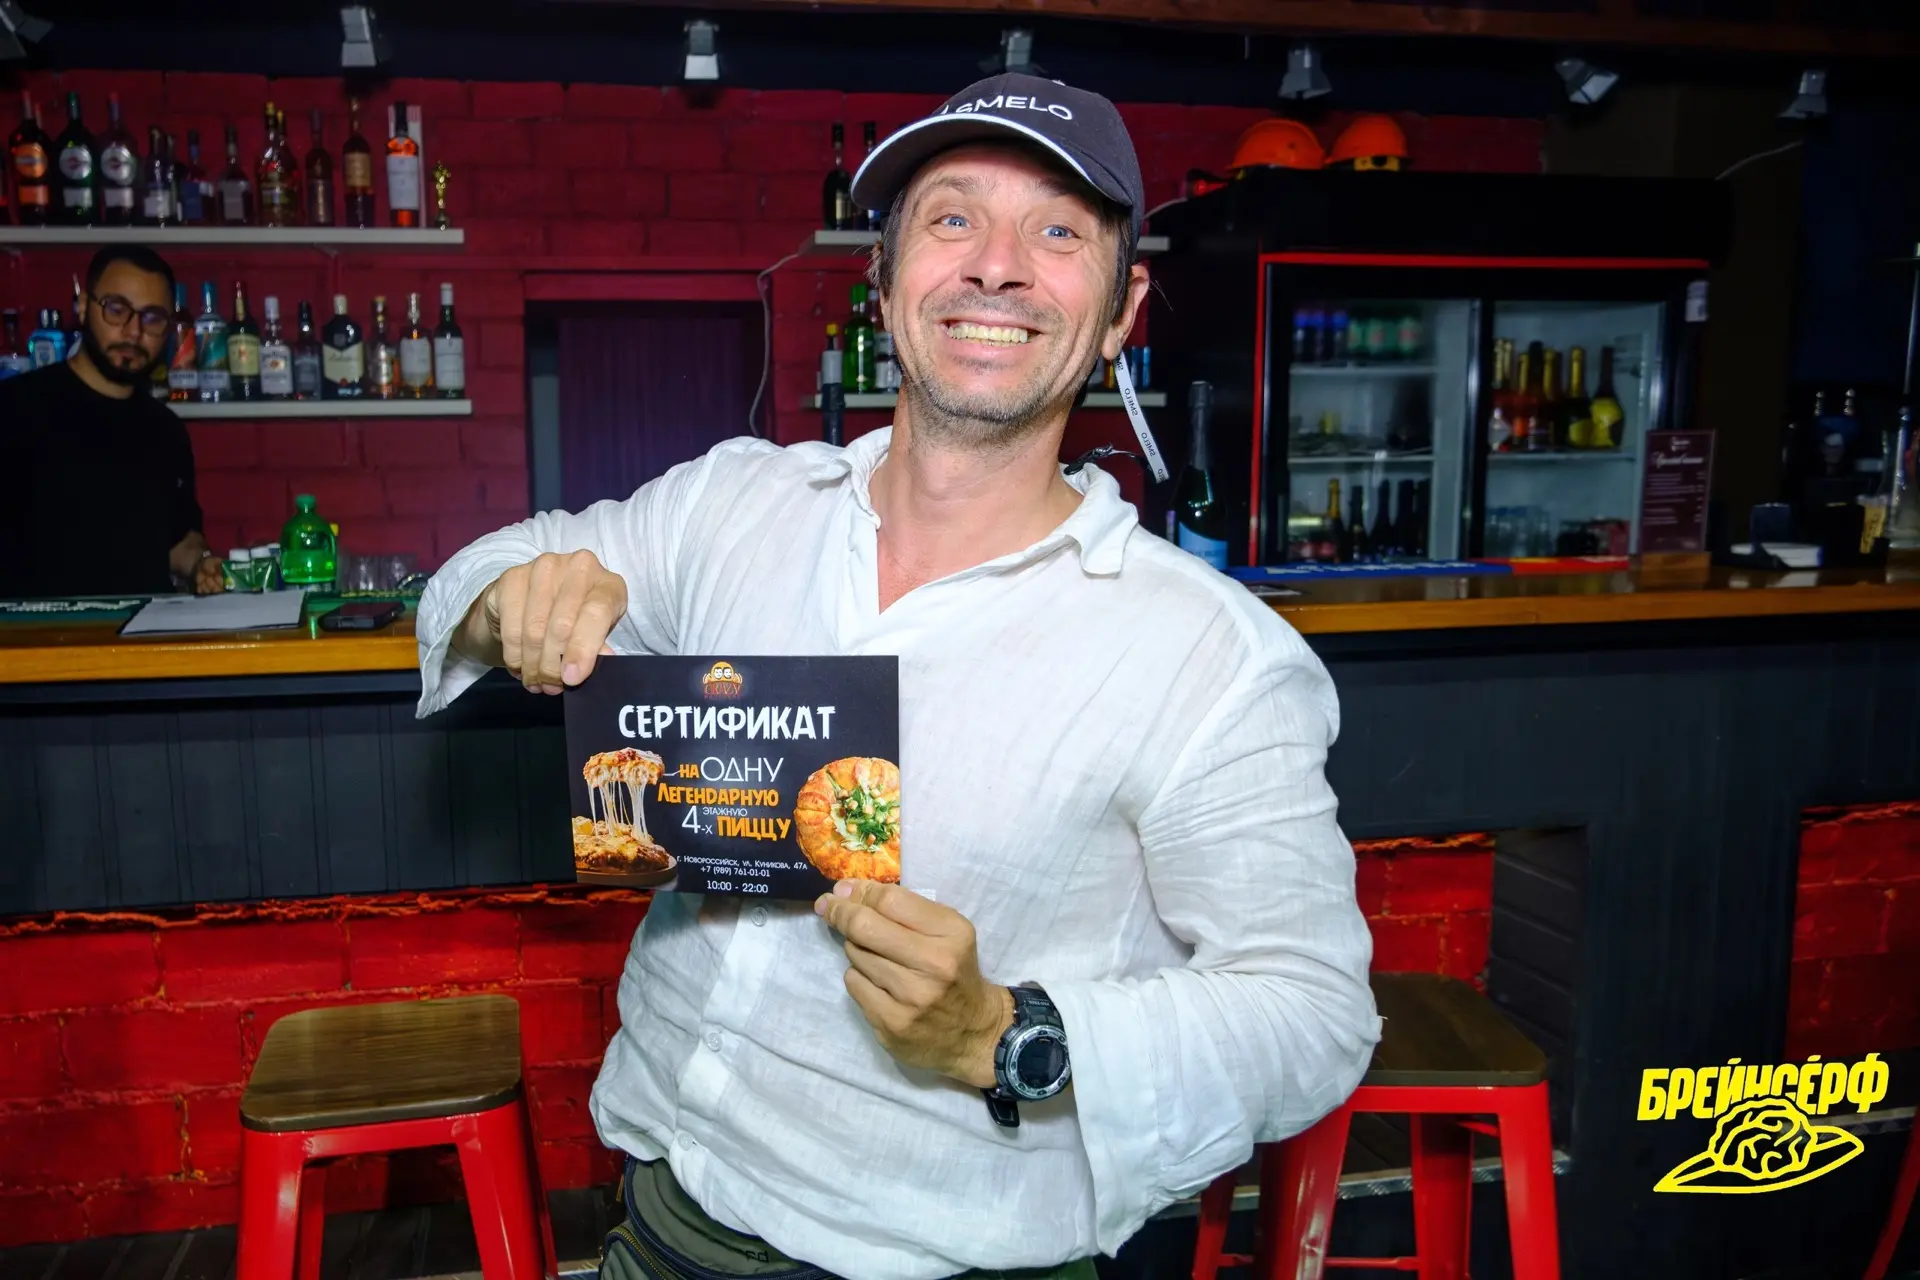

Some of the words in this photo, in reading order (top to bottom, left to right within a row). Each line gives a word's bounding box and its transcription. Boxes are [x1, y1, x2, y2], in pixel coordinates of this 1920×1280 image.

[618, 704, 836, 740] СЕРТИФИКАТ
[680, 764, 699, 778] НА
[700, 756, 784, 782] ОДНУ
[657, 783, 780, 807] ЛЕГЕНДАРНУЮ
[702, 806, 748, 817] ЭТАЖНУЮ
[717, 816, 791, 841] ПИЦЦУ
[713, 866, 732, 875] (989)
[734, 867, 770, 877] 761-01-01
[707, 880, 732, 891] 10:00
[742, 883, 768, 893] 22:00
